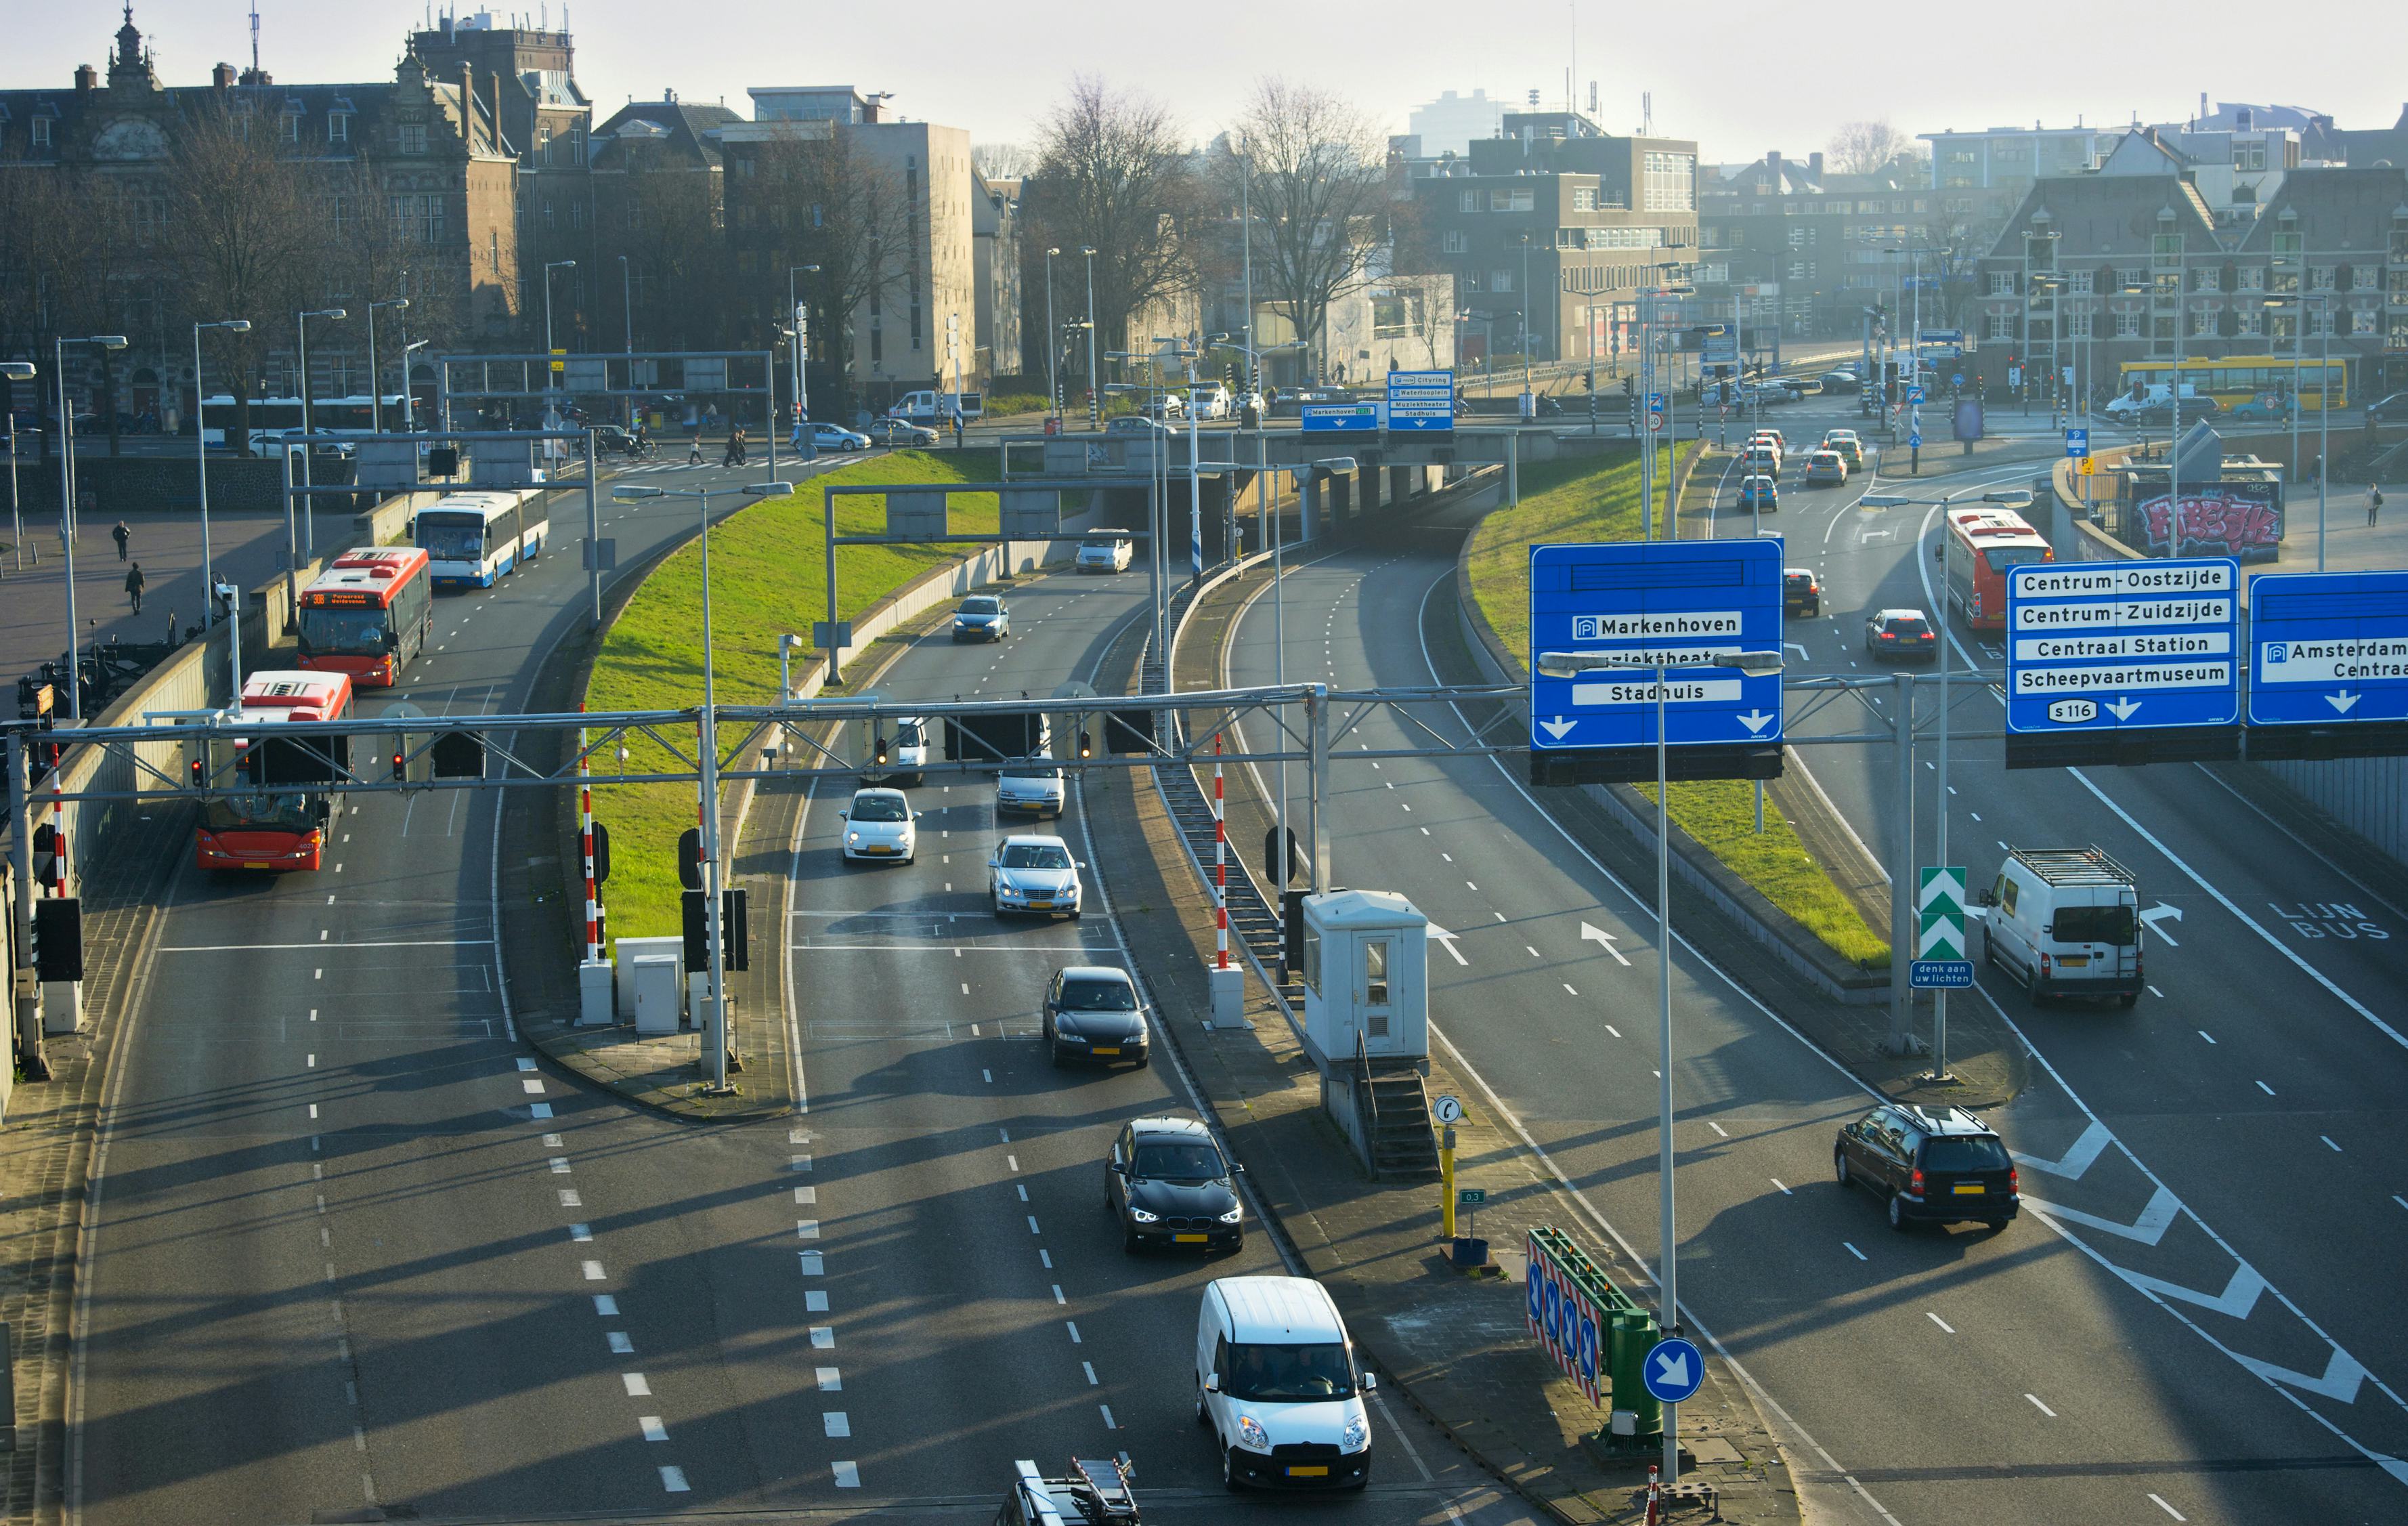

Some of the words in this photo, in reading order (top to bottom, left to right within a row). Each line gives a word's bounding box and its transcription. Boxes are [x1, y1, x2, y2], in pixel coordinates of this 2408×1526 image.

[1602, 617, 1736, 635] Markenhoven
[2038, 639, 2126, 657] Centraal
[2135, 637, 2208, 653] Station
[2292, 642, 2407, 659] Amsterdam
[2022, 669, 2224, 688] Scheepvaartmuseum
[1611, 685, 1704, 701] Stadhuis
[2067, 705, 2091, 717] 116
[2268, 903, 2367, 919] LIJN
[2289, 922, 2390, 939] BUS
[1919, 965, 1944, 973] denk
[1932, 974, 1969, 982] lichten
